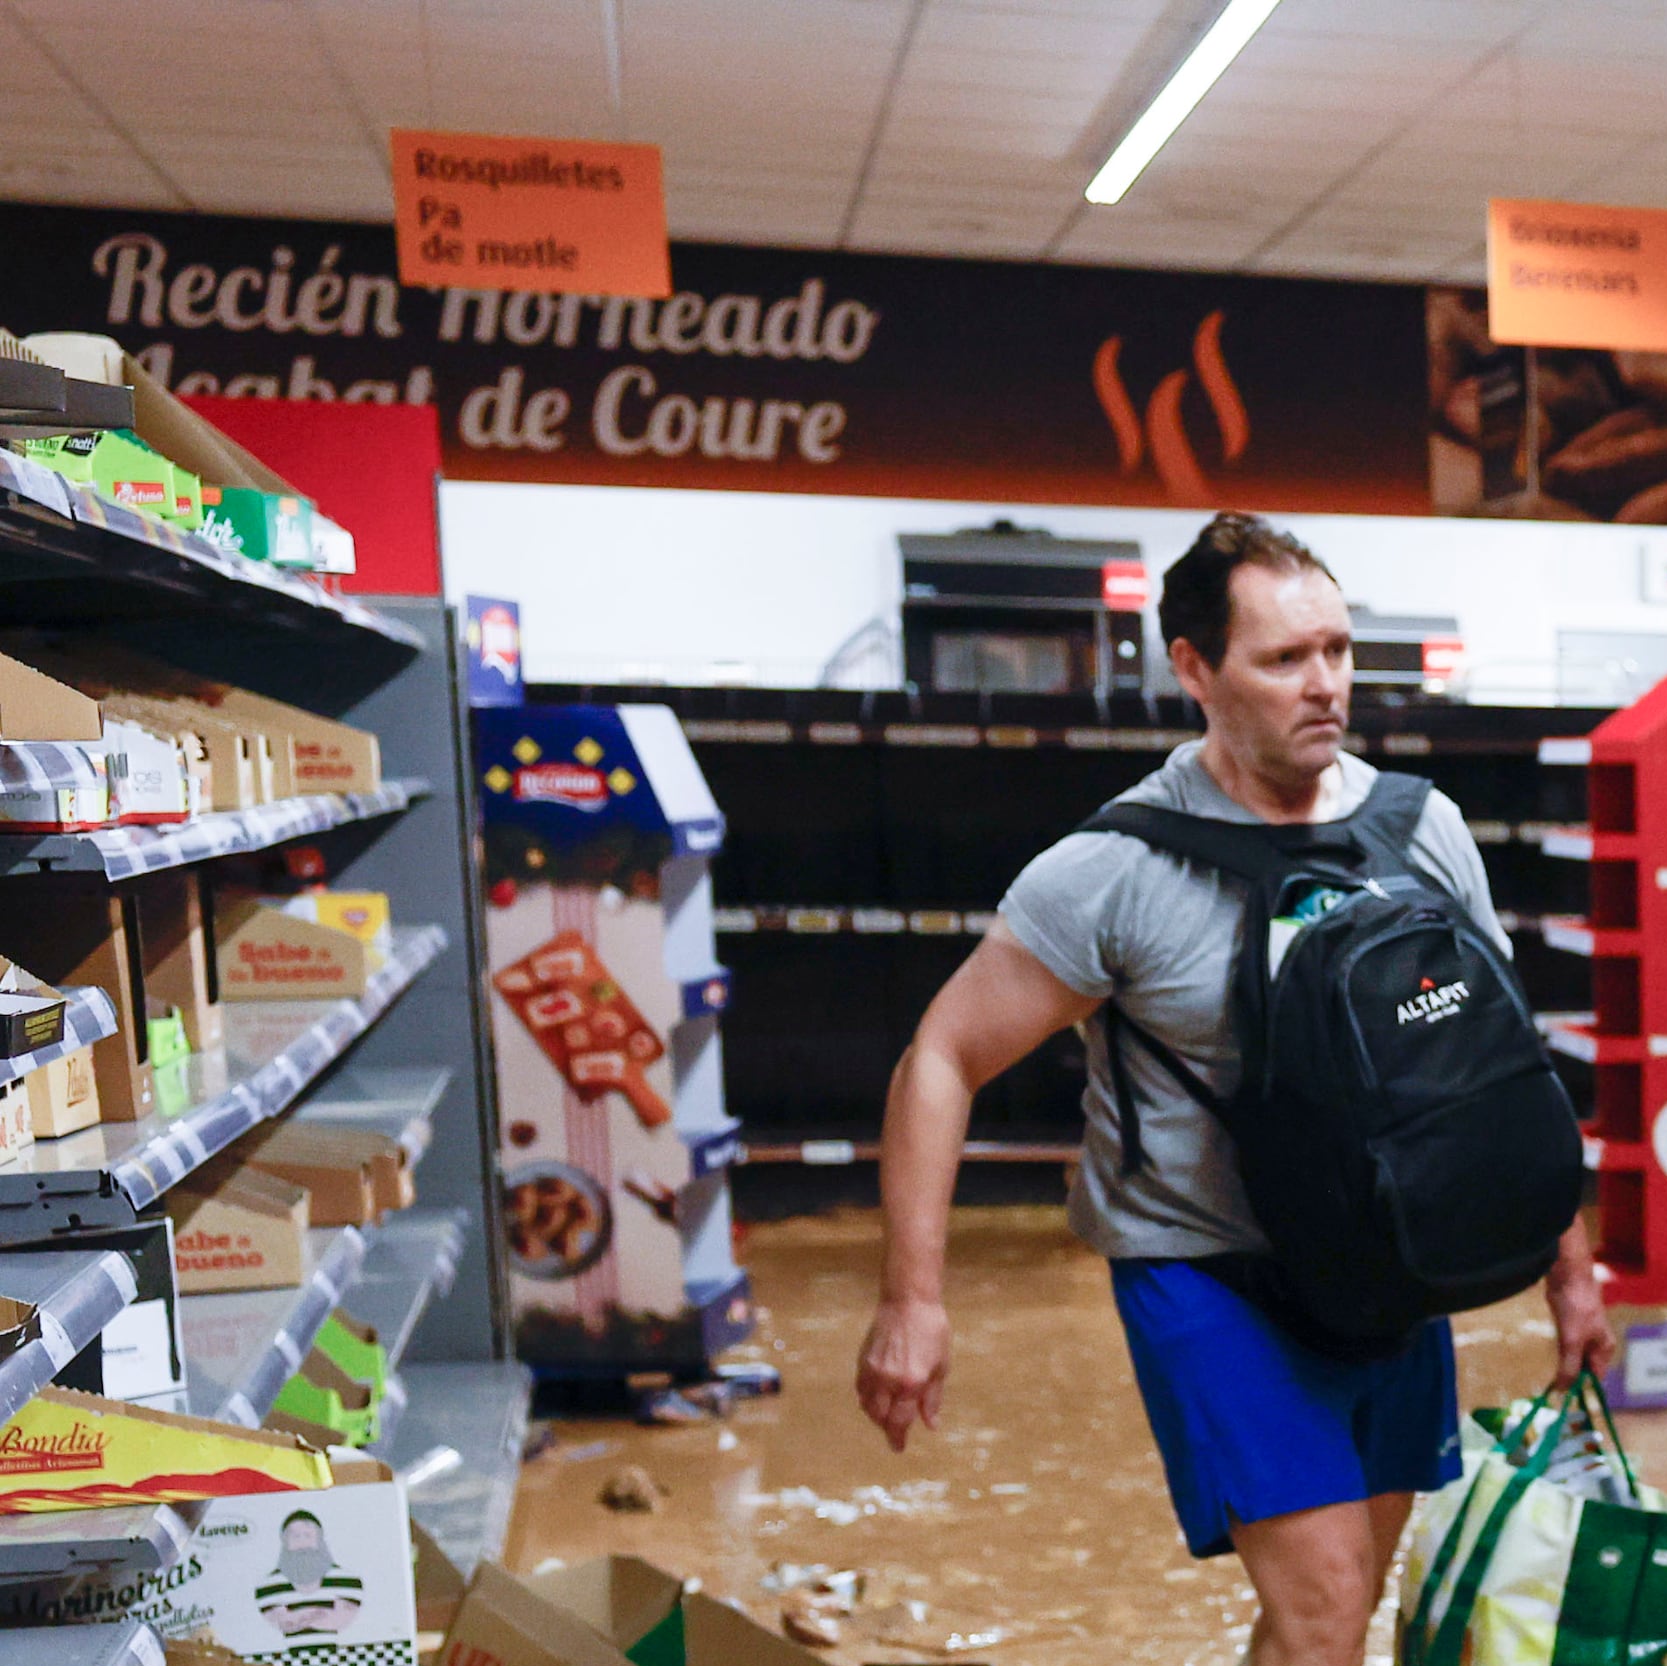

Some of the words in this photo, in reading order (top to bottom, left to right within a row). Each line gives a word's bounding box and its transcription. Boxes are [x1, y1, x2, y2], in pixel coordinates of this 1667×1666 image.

[414, 147, 625, 193] Rosquilletes
[418, 197, 462, 231] Pa
[421, 232, 467, 267] de
[477, 233, 579, 272] motle
[93, 232, 402, 337] Recién
[459, 364, 570, 454] de
[592, 369, 848, 464] Coure
[1396, 980, 1470, 1026] ALTAFIT
[176, 1230, 231, 1252] abe
[1, 1421, 112, 1454] Bondia
